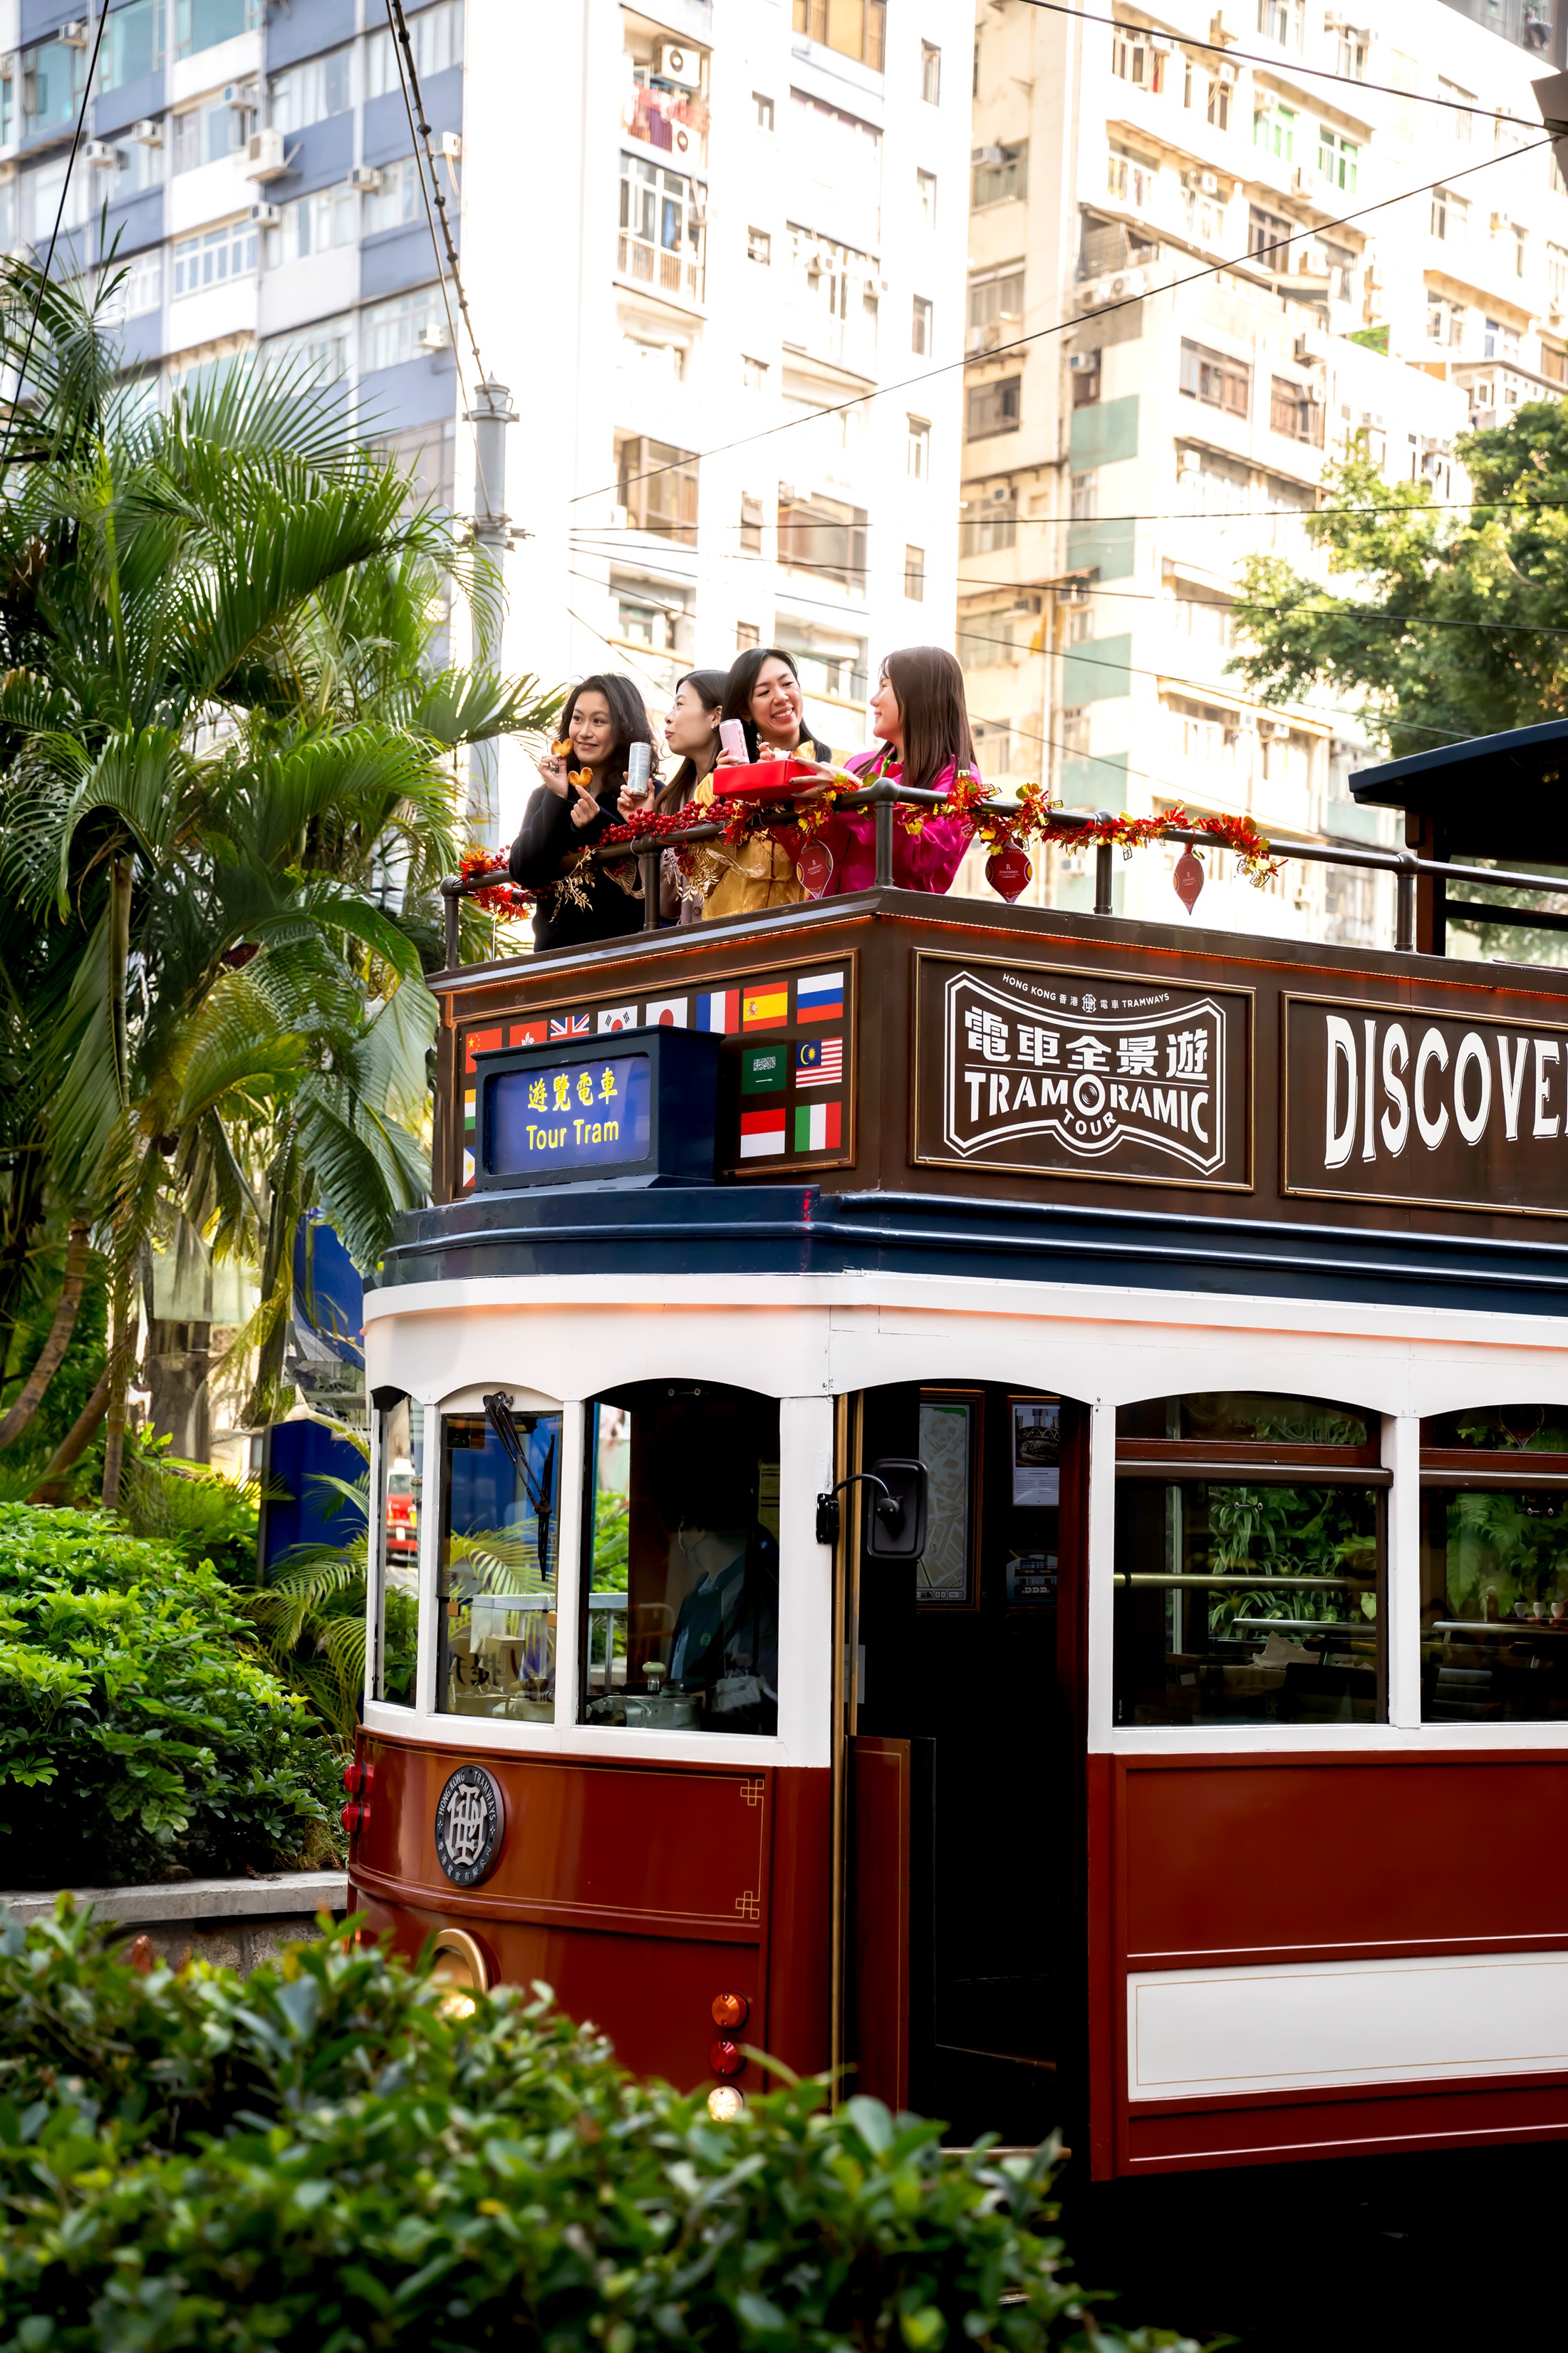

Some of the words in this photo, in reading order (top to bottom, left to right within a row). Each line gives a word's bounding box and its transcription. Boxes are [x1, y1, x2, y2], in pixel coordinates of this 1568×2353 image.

[1002, 973, 1028, 991] HONG
[1031, 986, 1056, 1000] KONG
[1059, 993, 1079, 1006] 香港
[1100, 999, 1119, 1009] 電車
[1122, 993, 1170, 1008] TRAMWAYS
[965, 1005, 1208, 1080] 電車全景遊
[528, 1067, 618, 1112] 遊覽電車
[965, 1072, 1209, 1143] TRAMORAMIC
[1324, 1015, 1568, 1169] DISCOVE
[526, 1125, 567, 1150] Tour
[573, 1119, 619, 1144] Tram
[1063, 1109, 1117, 1137] TOUR
[438, 1788, 451, 1816] HONG
[450, 1770, 465, 1791] KONG
[474, 1771, 496, 1821] TRAMWAYS
[438, 1841, 492, 1882] 香港電車有限公司
